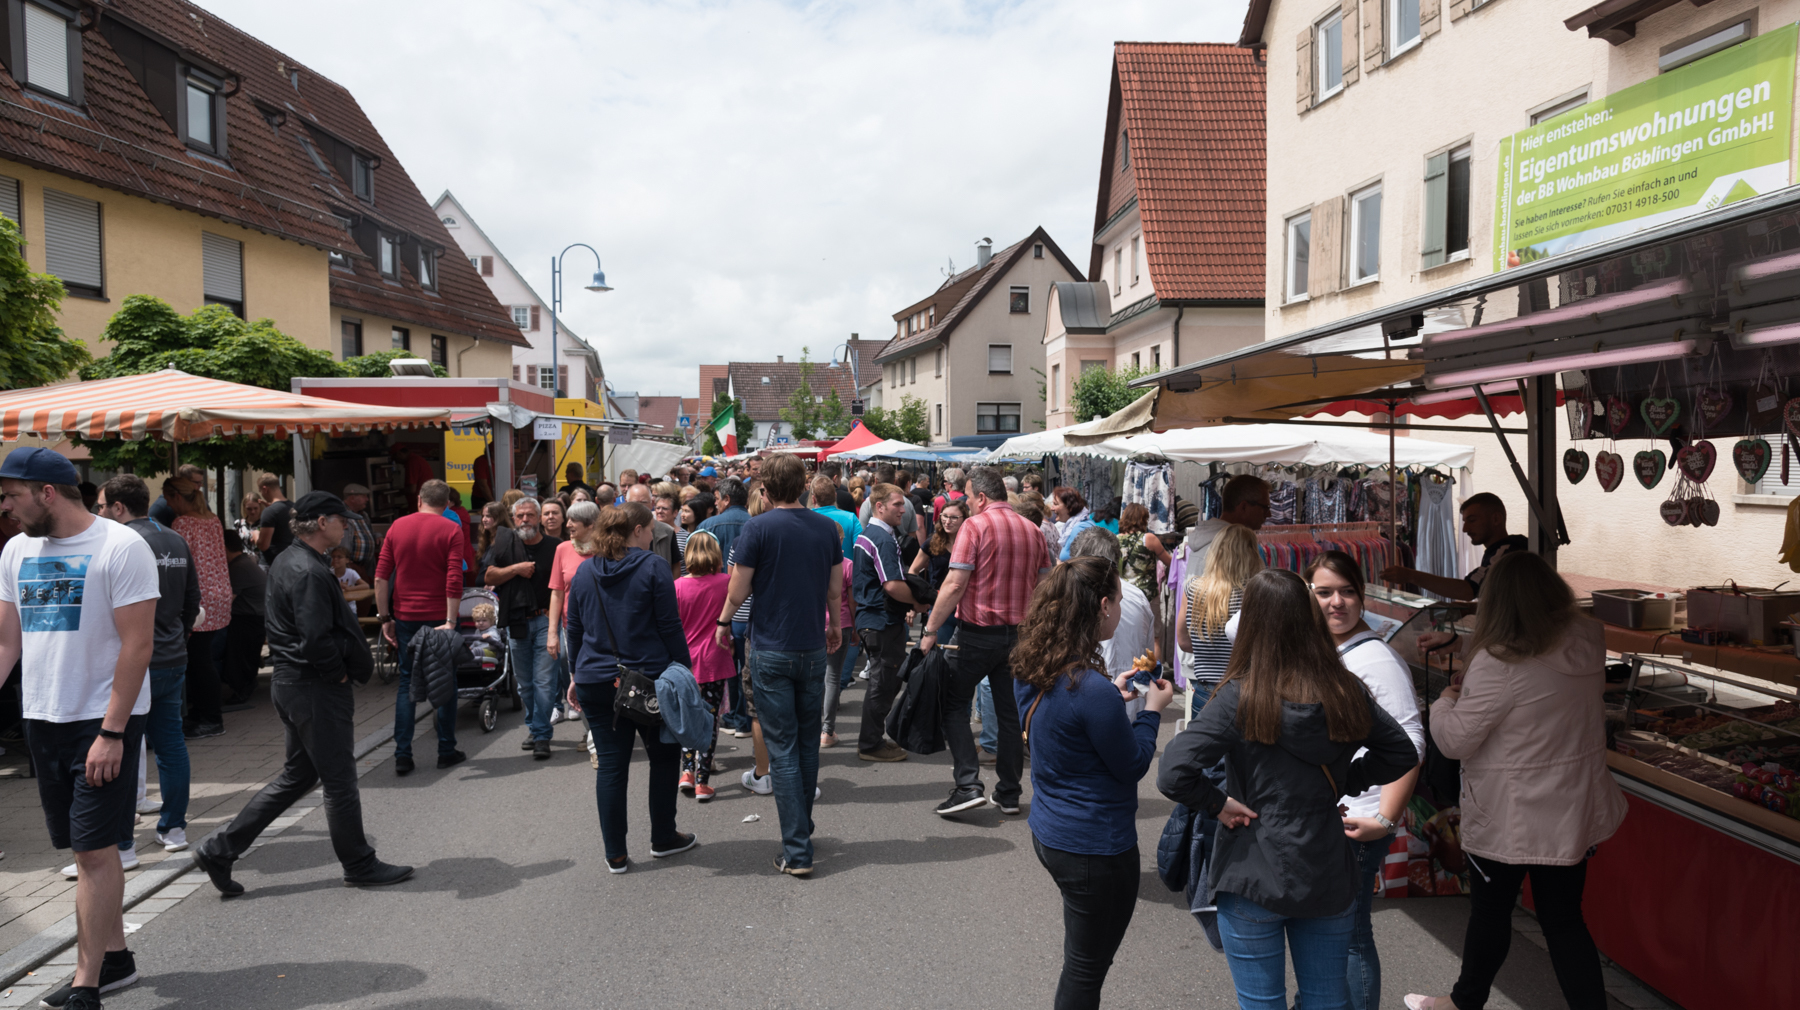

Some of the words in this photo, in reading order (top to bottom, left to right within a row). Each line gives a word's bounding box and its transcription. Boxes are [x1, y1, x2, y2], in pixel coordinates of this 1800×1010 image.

[1519, 81, 1770, 184] Eigentumswohnungen
[1520, 134, 1544, 154] Hier
[1546, 108, 1613, 142] entstehen:
[1517, 190, 1536, 206] der
[1538, 179, 1554, 197] BB
[1557, 162, 1618, 194] Wohnbau
[1622, 134, 1703, 173] Böblingen
[1708, 111, 1774, 146] GmbH!
[1514, 218, 1525, 228] Sie
[1526, 210, 1547, 225] haben
[1549, 198, 1586, 218] Interesse?
[1588, 192, 1610, 206] Rufen
[1612, 188, 1625, 199] Sie
[1627, 178, 1660, 196] einfach
[1664, 176, 1676, 186] an
[1678, 167, 1698, 182] und
[1514, 228, 1532, 241] lassen
[1534, 224, 1544, 236] Sie
[1546, 218, 1560, 232] sich
[1562, 208, 1604, 228] vormerken:
[1606, 200, 1632, 216] 07031
[1636, 189, 1679, 209] 4918-500
[1706, 194, 1720, 210] BB
[447, 461, 474, 471] Supp
[21, 587, 74, 599] REEF
